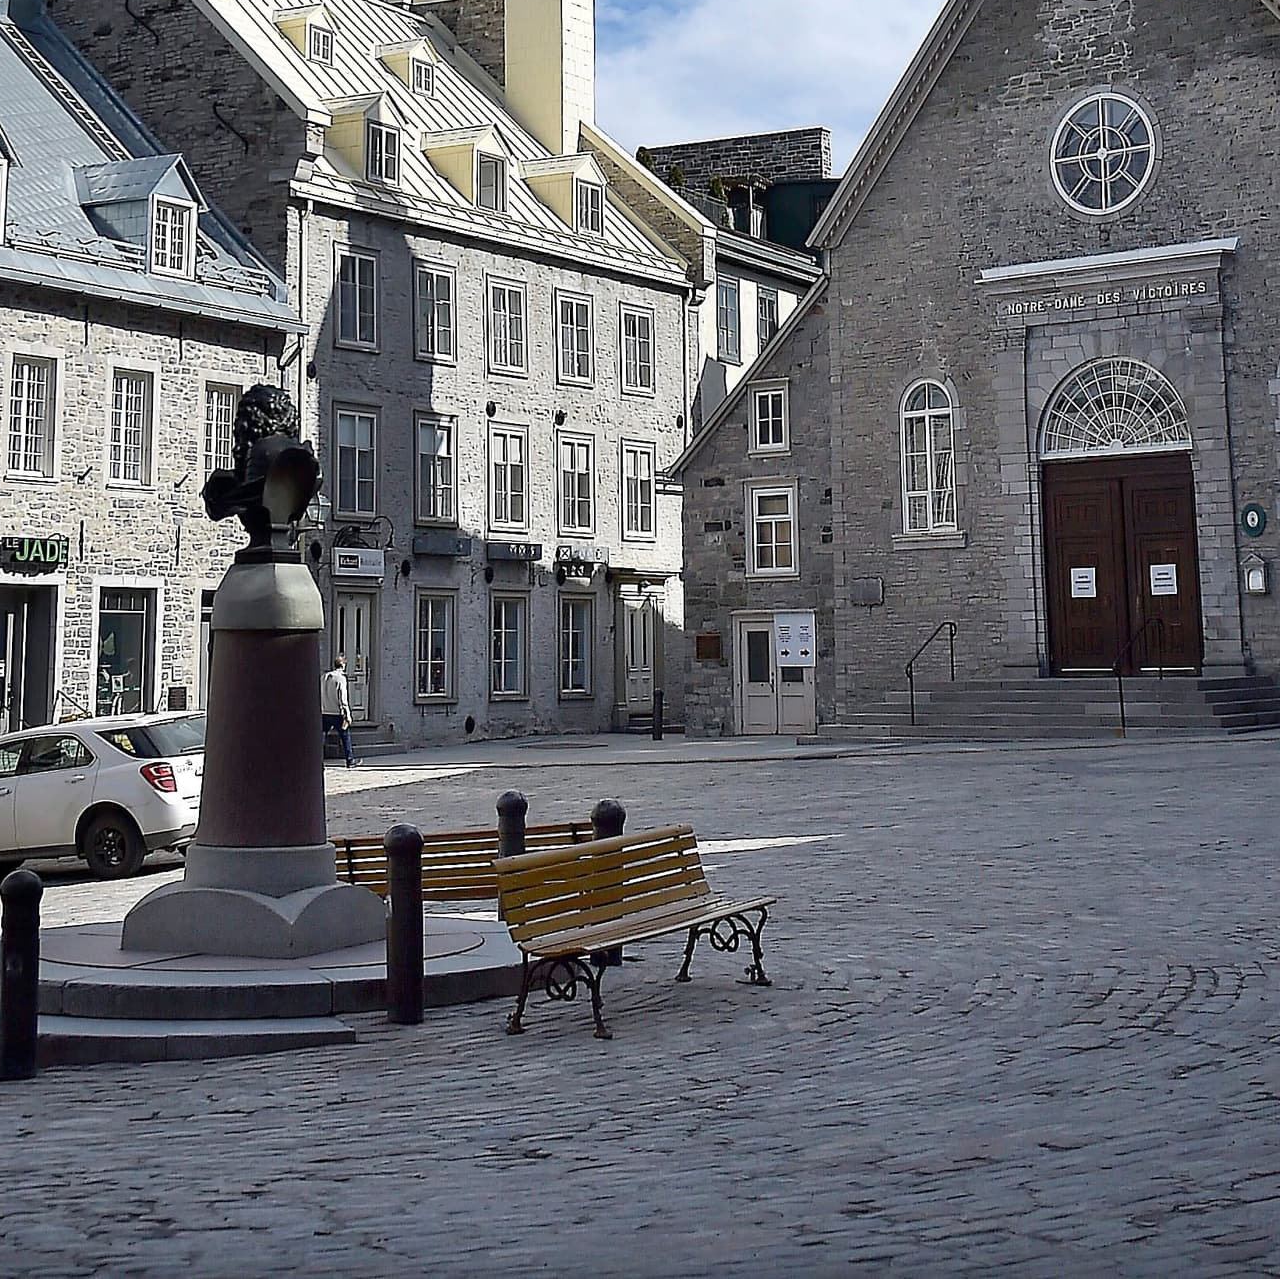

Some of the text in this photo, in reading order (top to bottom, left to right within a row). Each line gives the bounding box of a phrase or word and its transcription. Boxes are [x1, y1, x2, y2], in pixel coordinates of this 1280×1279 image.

[1008, 281, 1207, 315] NOTRE-DAME DES VICTOIRES
[6, 538, 68, 563] LE JADE
